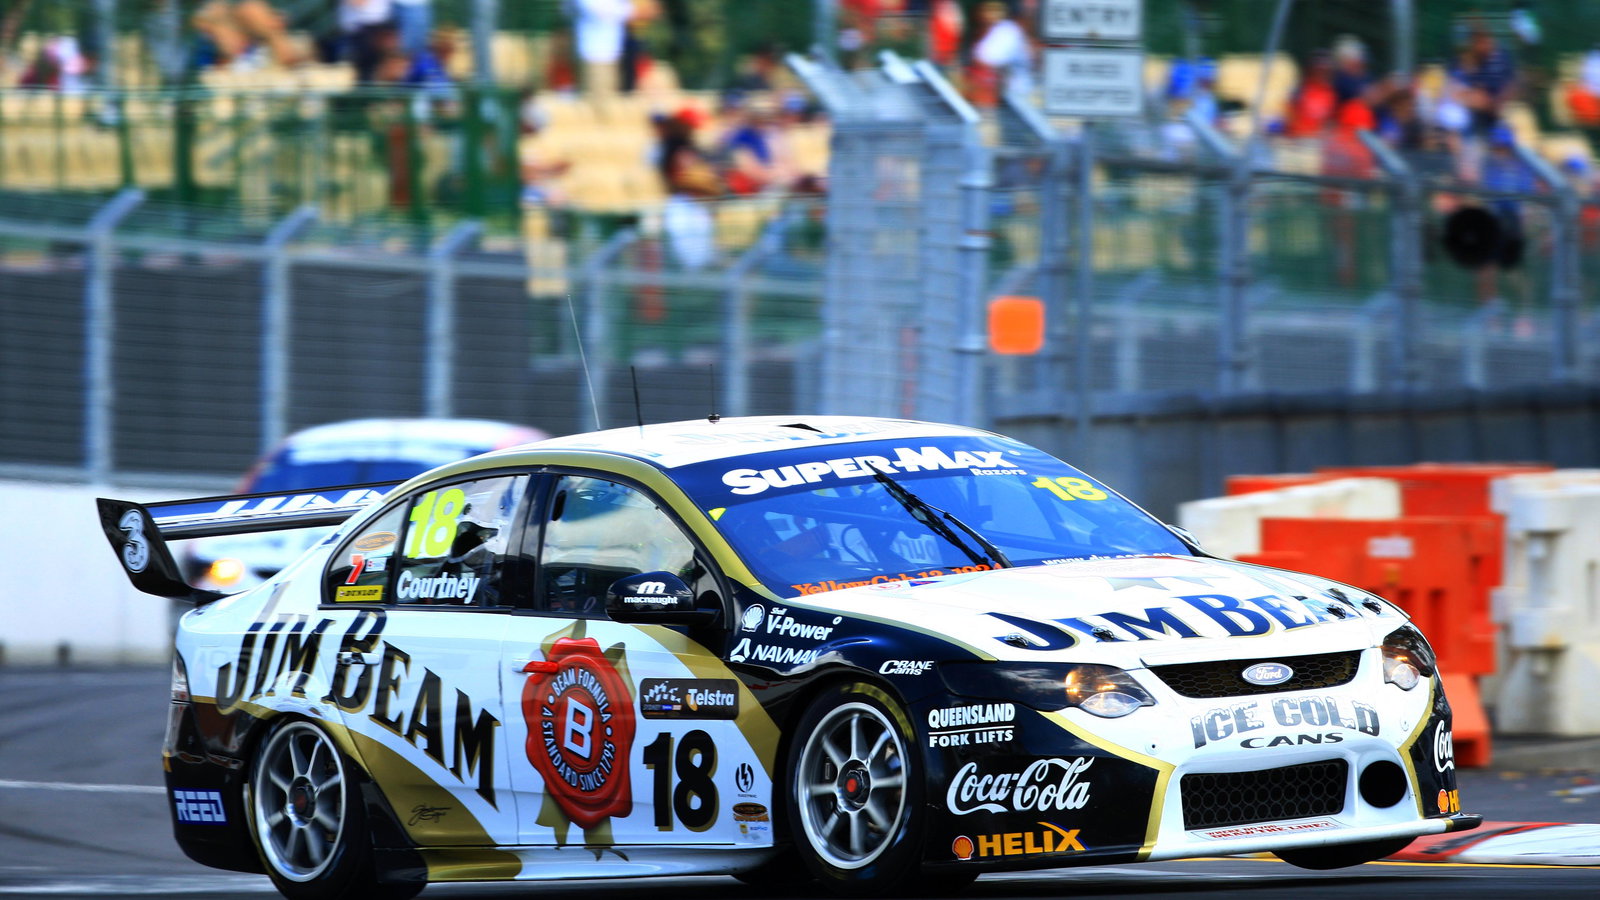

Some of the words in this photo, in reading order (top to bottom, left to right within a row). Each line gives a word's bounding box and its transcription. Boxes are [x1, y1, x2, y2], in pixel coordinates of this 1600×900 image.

[1048, 0, 1133, 26] ENTRY
[969, 467, 1027, 477] Razors
[1031, 477, 1108, 501] 18
[407, 488, 465, 558] 18
[344, 588, 379, 597] DUNLOP
[397, 570, 480, 604] Courtney
[624, 596, 678, 605] macnaught
[766, 614, 833, 641] V-Power
[986, 606, 1203, 651] JIM
[752, 644, 822, 665] NAVMAN
[1256, 666, 1283, 681] Ford
[216, 580, 336, 716] JIM
[321, 609, 502, 812] BEAM
[551, 668, 576, 696] BEAM
[578, 668, 612, 723] FORMULA
[688, 689, 735, 706] Telstra
[542, 706, 554, 717] A
[928, 703, 1016, 730] QUEENSLAND
[1191, 700, 1265, 750] ICE
[1271, 695, 1381, 737] COLD
[564, 696, 594, 759] B
[929, 734, 970, 747] FORK
[975, 729, 1014, 745] LIFTS
[1239, 732, 1345, 749] CANS
[542, 721, 578, 787] STANDARD
[600, 740, 616, 774] 1795
[579, 767, 606, 791] SINCE
[642, 729, 719, 832] 18
[946, 756, 1095, 816] Coca-Cola
[173, 790, 226, 822] REED
[977, 822, 1089, 857] HELIX
